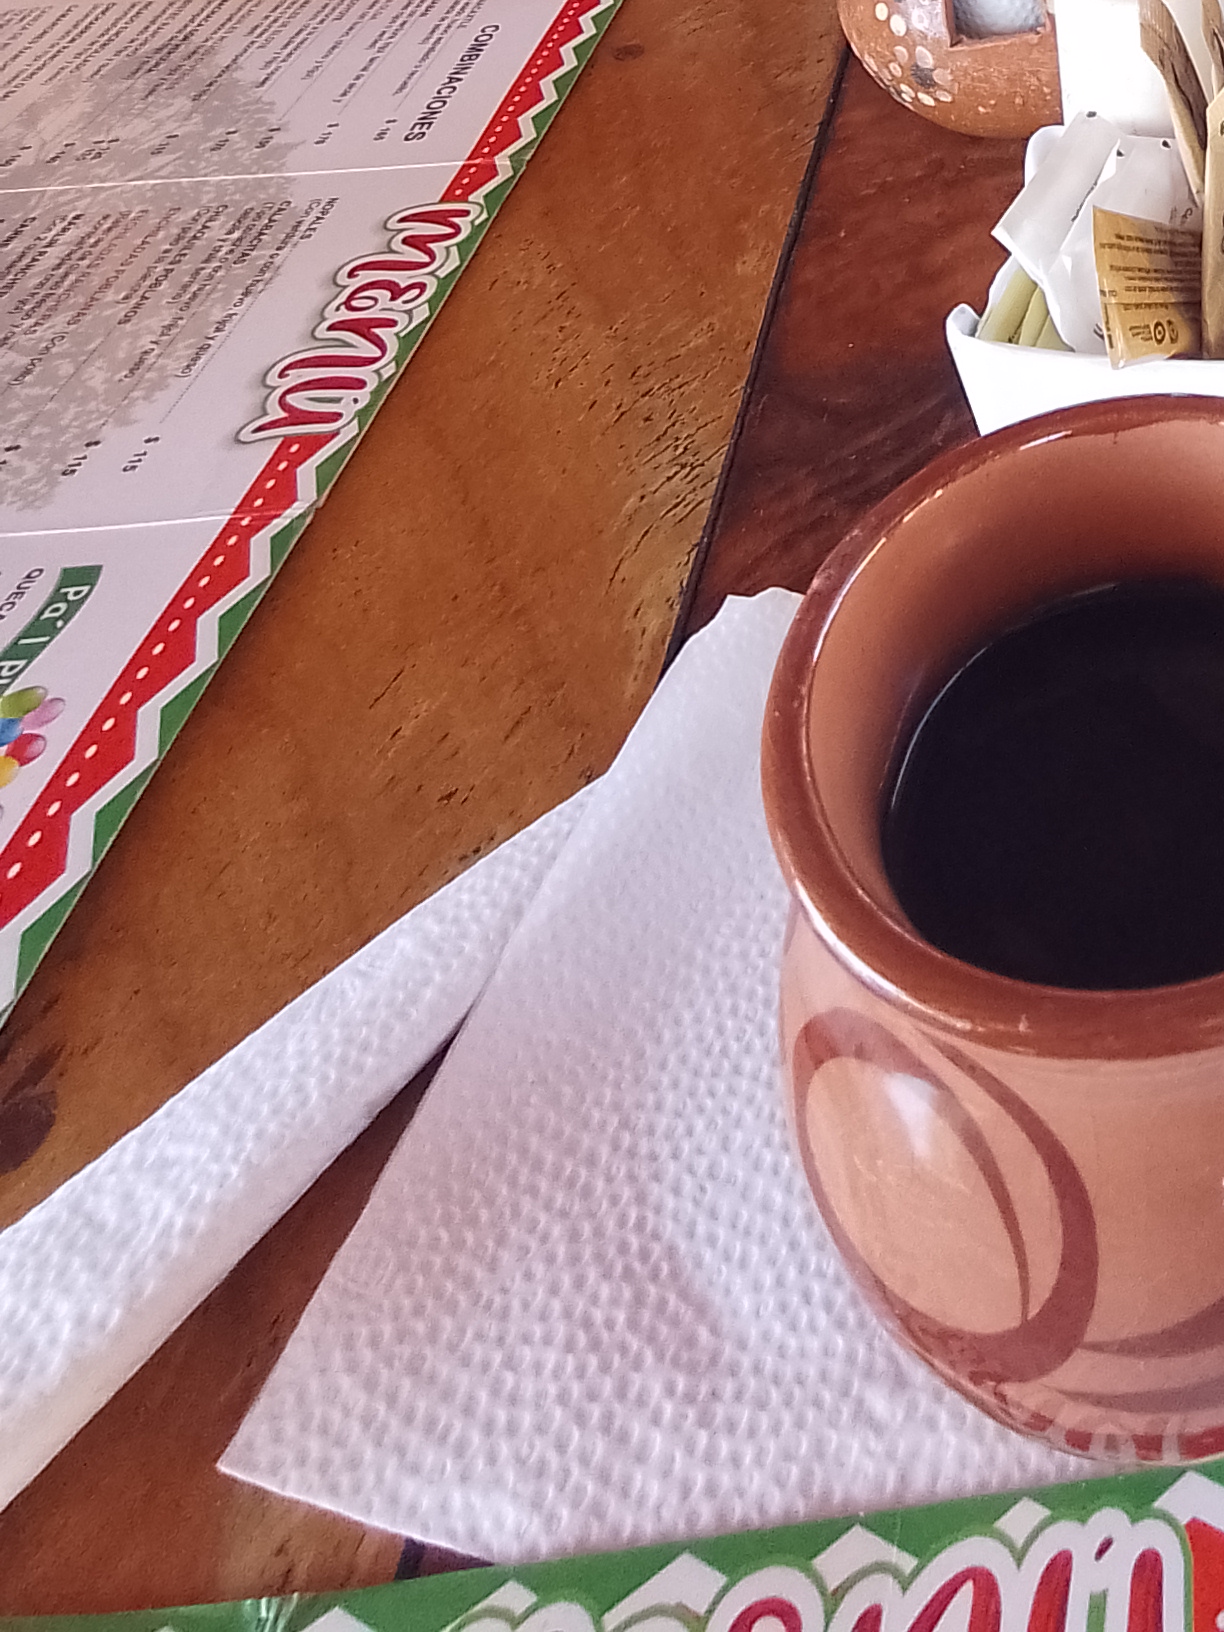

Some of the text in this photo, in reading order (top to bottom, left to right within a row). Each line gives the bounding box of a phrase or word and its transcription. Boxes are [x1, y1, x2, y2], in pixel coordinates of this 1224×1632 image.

[403, 24, 500, 142] COMBINACIONES
[169, 204, 228, 265] CHILAQUILES
[300, 197, 338, 240] NOPALES
[117, 267, 174, 325] POBLANOS
[60, 200, 291, 476] CALABACITAS $ 115
[174, 343, 211, 379] queso)
[121, 451, 148, 472] 115
